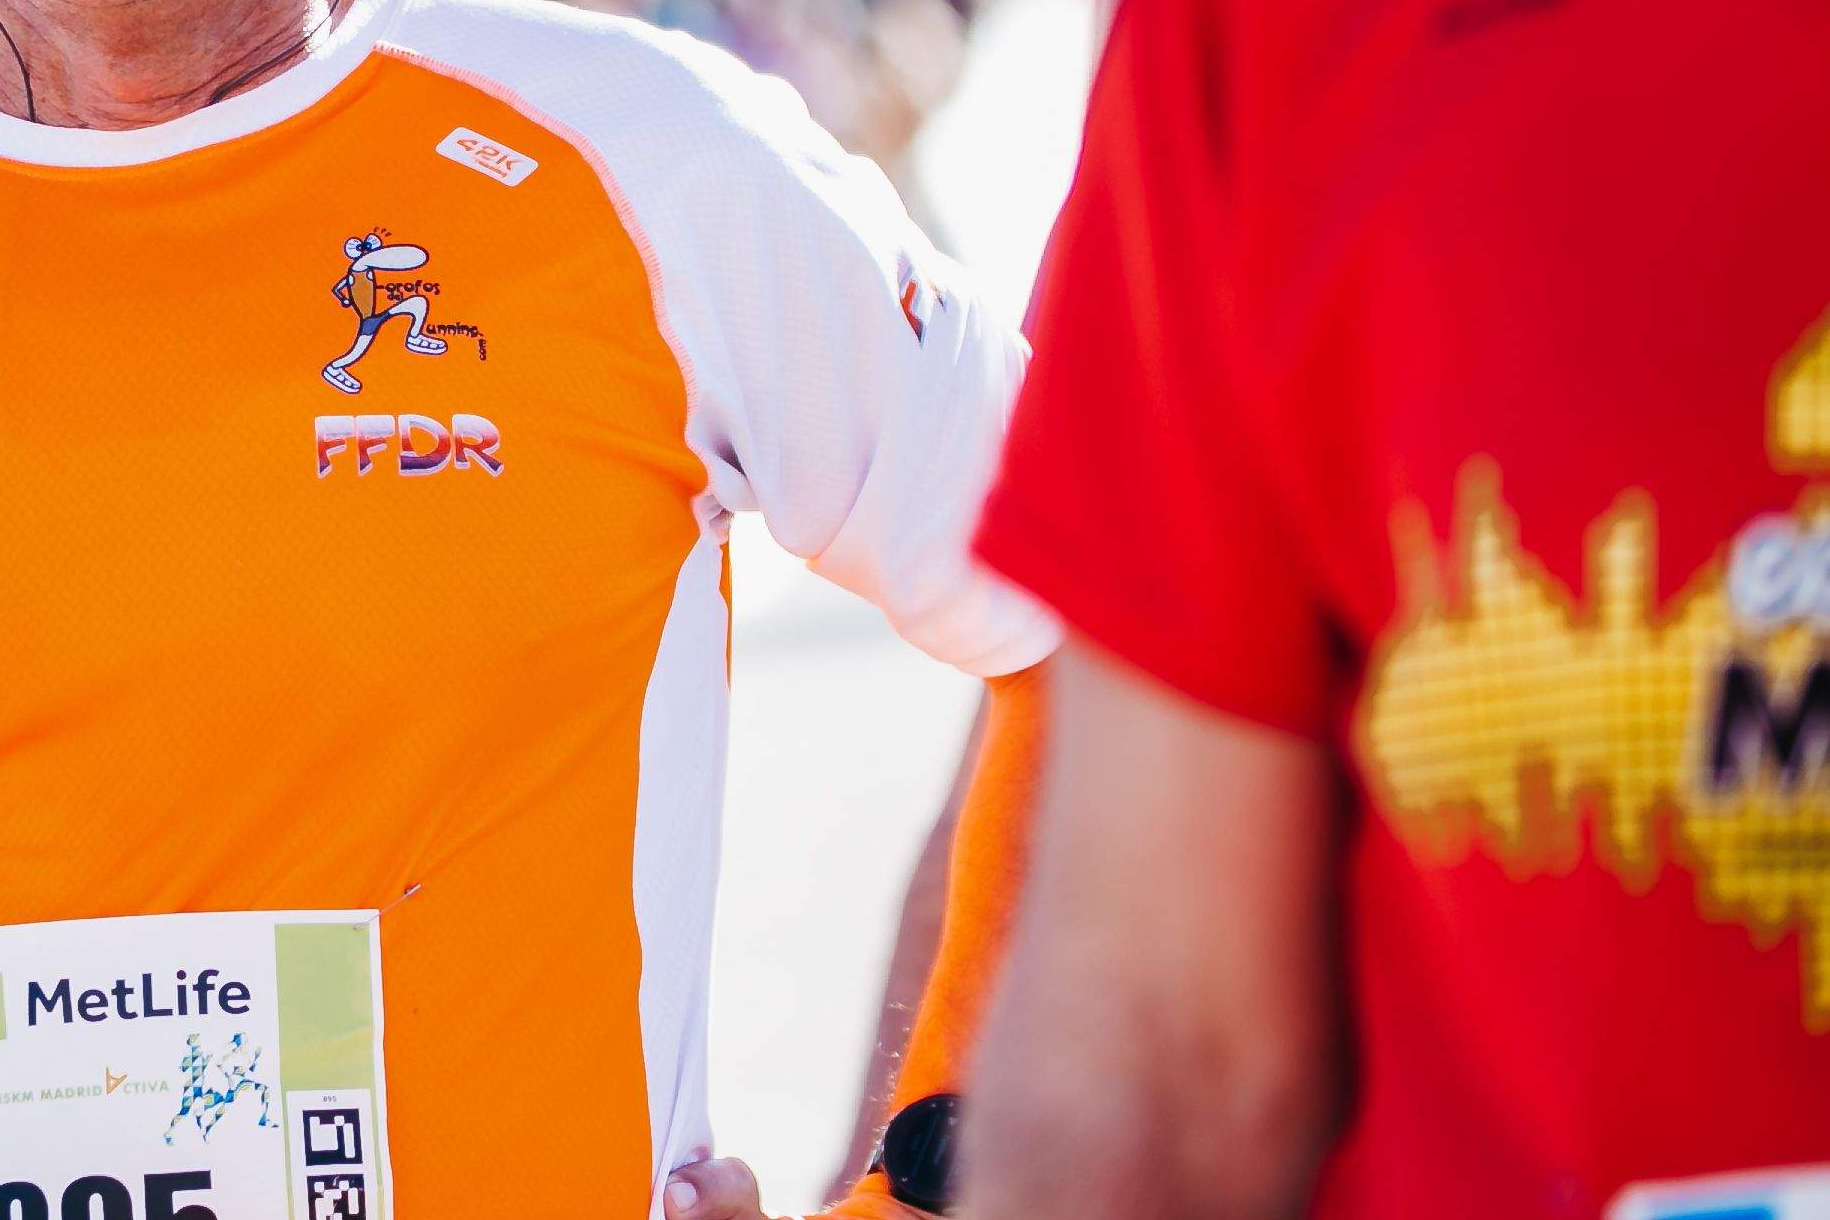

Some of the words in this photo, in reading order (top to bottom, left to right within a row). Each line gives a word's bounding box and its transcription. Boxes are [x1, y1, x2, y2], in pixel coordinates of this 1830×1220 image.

[314, 414, 505, 479] FFDR
[27, 968, 252, 1027] MetLife
[39, 1084, 103, 1101] MADRID
